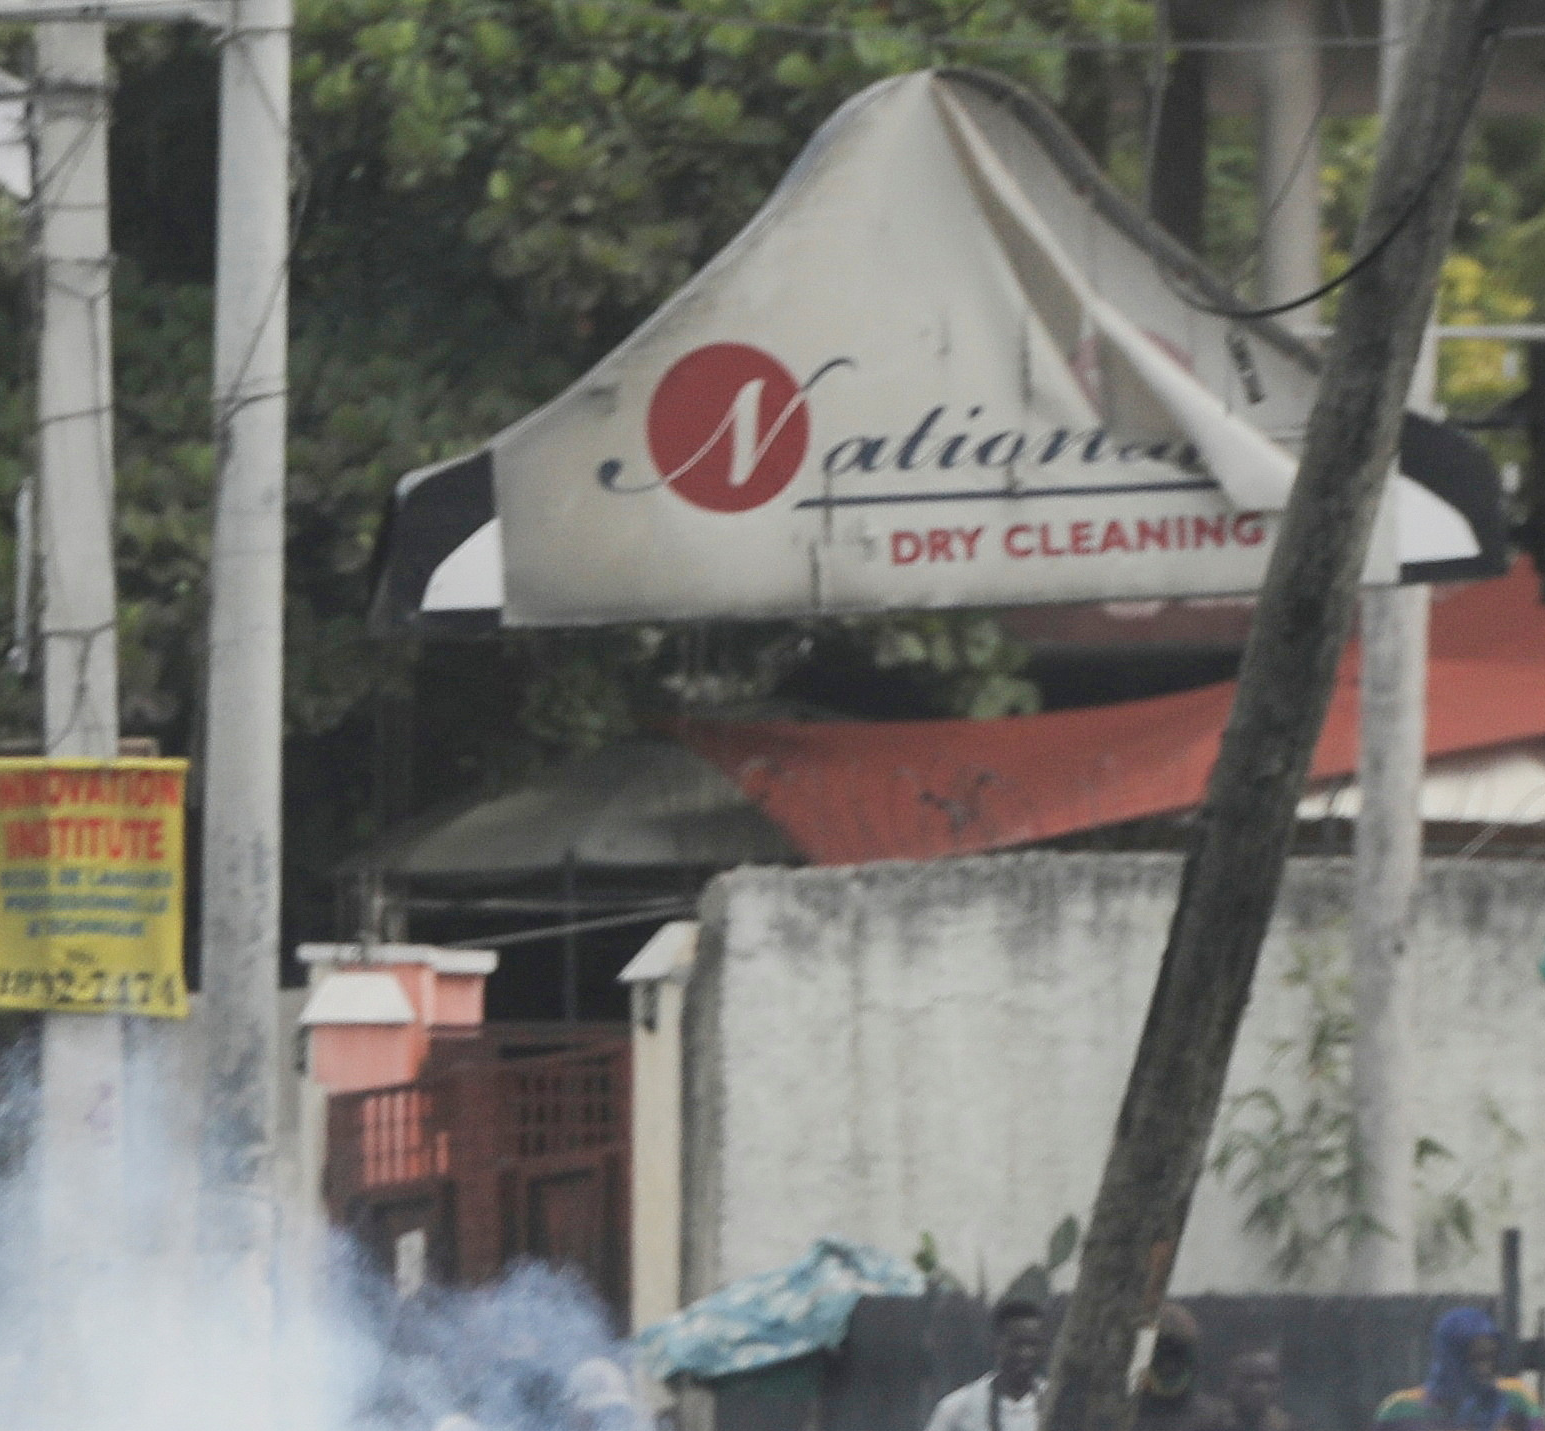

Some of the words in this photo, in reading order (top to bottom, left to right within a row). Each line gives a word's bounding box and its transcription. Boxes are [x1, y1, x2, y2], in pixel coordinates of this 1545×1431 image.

[890, 525, 984, 569] DRY
[1003, 511, 1268, 561] CLEANING
[4, 817, 165, 860] INSTITUTE
